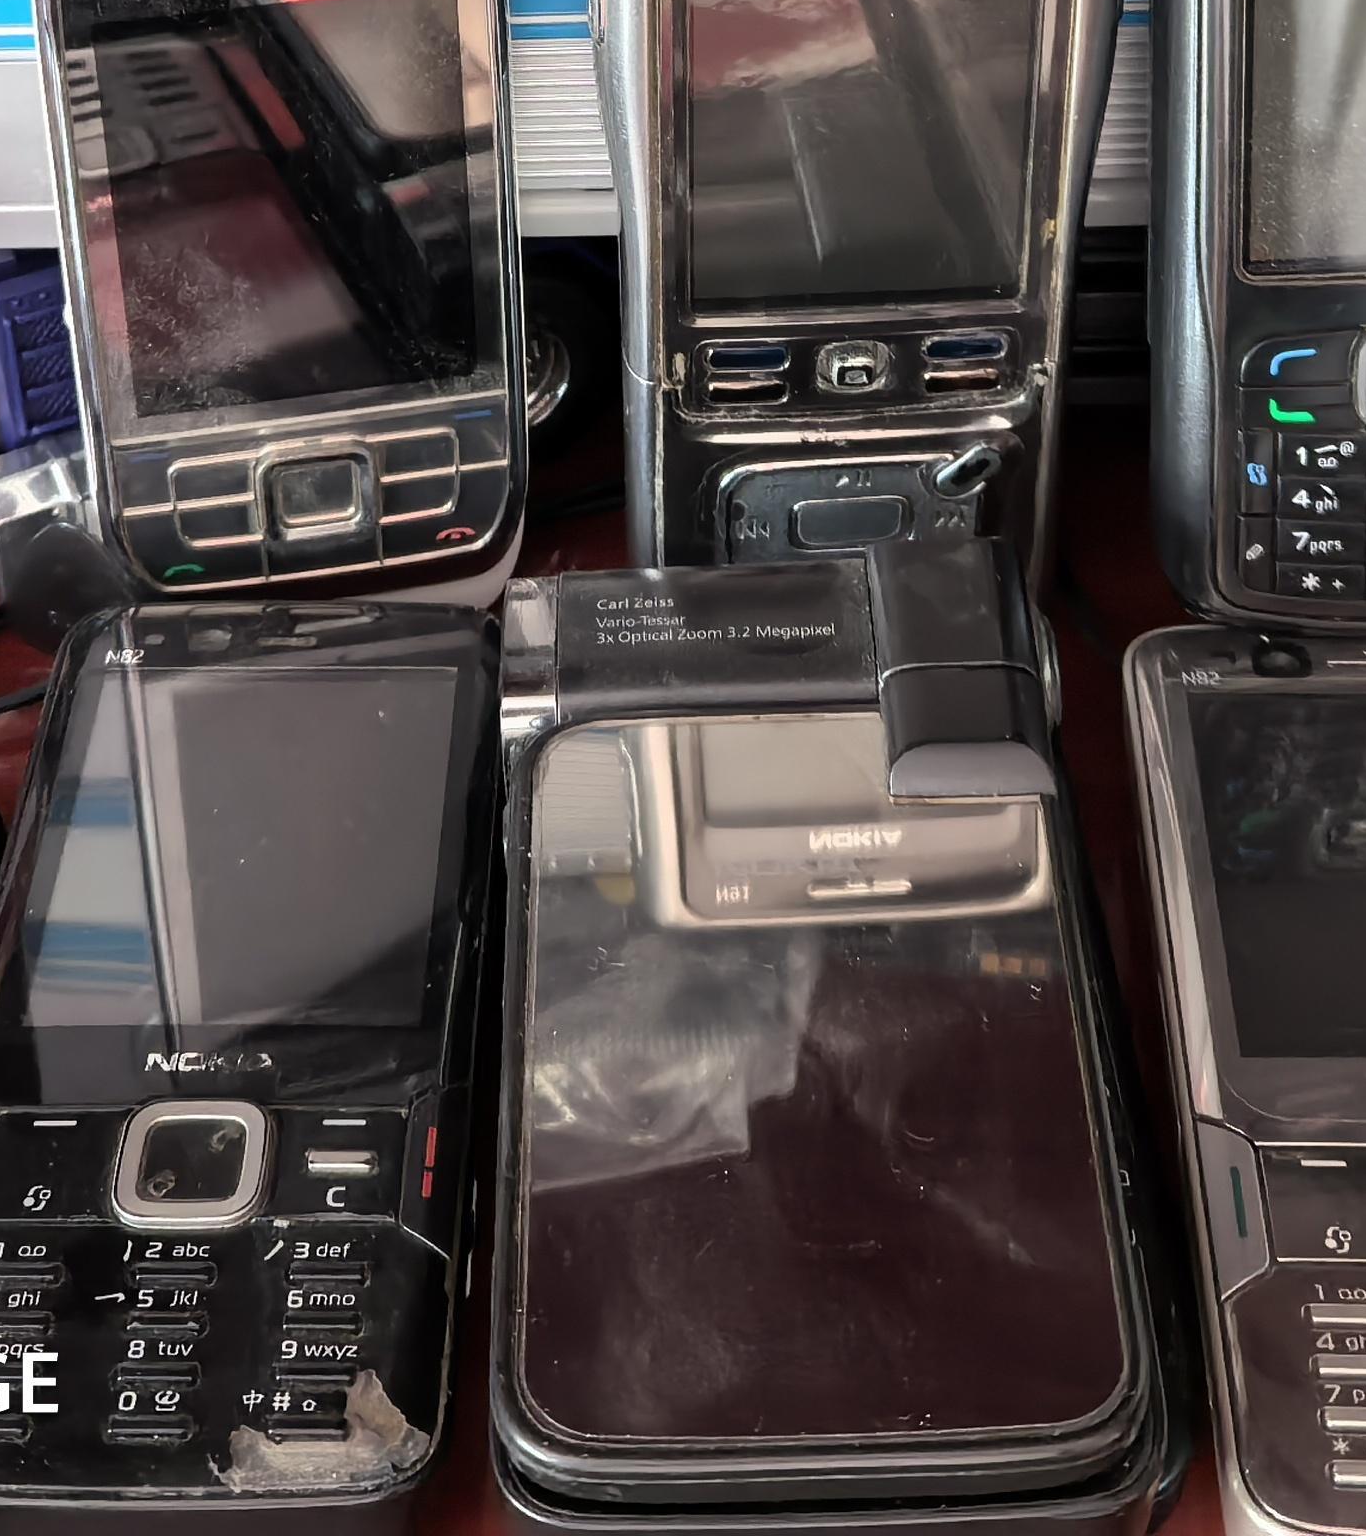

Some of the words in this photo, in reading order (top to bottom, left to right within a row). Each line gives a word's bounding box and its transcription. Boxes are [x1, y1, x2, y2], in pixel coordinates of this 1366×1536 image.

[1292, 489, 1312, 510] 4
[1292, 531, 1311, 551] 7
[597, 598, 629, 610] Carl
[634, 597, 674, 609] Zeiss
[596, 615, 686, 628] Vario-Tessar
[597, 632, 614, 644] 3x
[618, 629, 673, 645] Optical
[677, 628, 722, 641] Zoom
[727, 626, 750, 638] 3.2
[756, 623, 835, 640] Megapixel
[105, 649, 144, 664] N82
[1181, 671, 1222, 686] N82
[145, 1242, 161, 1257] 2
[172, 1241, 210, 1258] abc
[293, 1242, 310, 1258] 3
[316, 1241, 351, 1258] def
[8, 1290, 40, 1309] ghi
[136, 1290, 153, 1307] 5
[170, 1290, 198, 1309] jkl
[287, 1290, 303, 1308] 6
[309, 1292, 356, 1307] mno
[127, 1340, 145, 1359] 8
[158, 1340, 194, 1358] tuv
[281, 1341, 298, 1359] 9
[304, 1342, 358, 1359] wxyz
[1316, 1335, 1335, 1351] 4
[1324, 1385, 1341, 1403] 7
